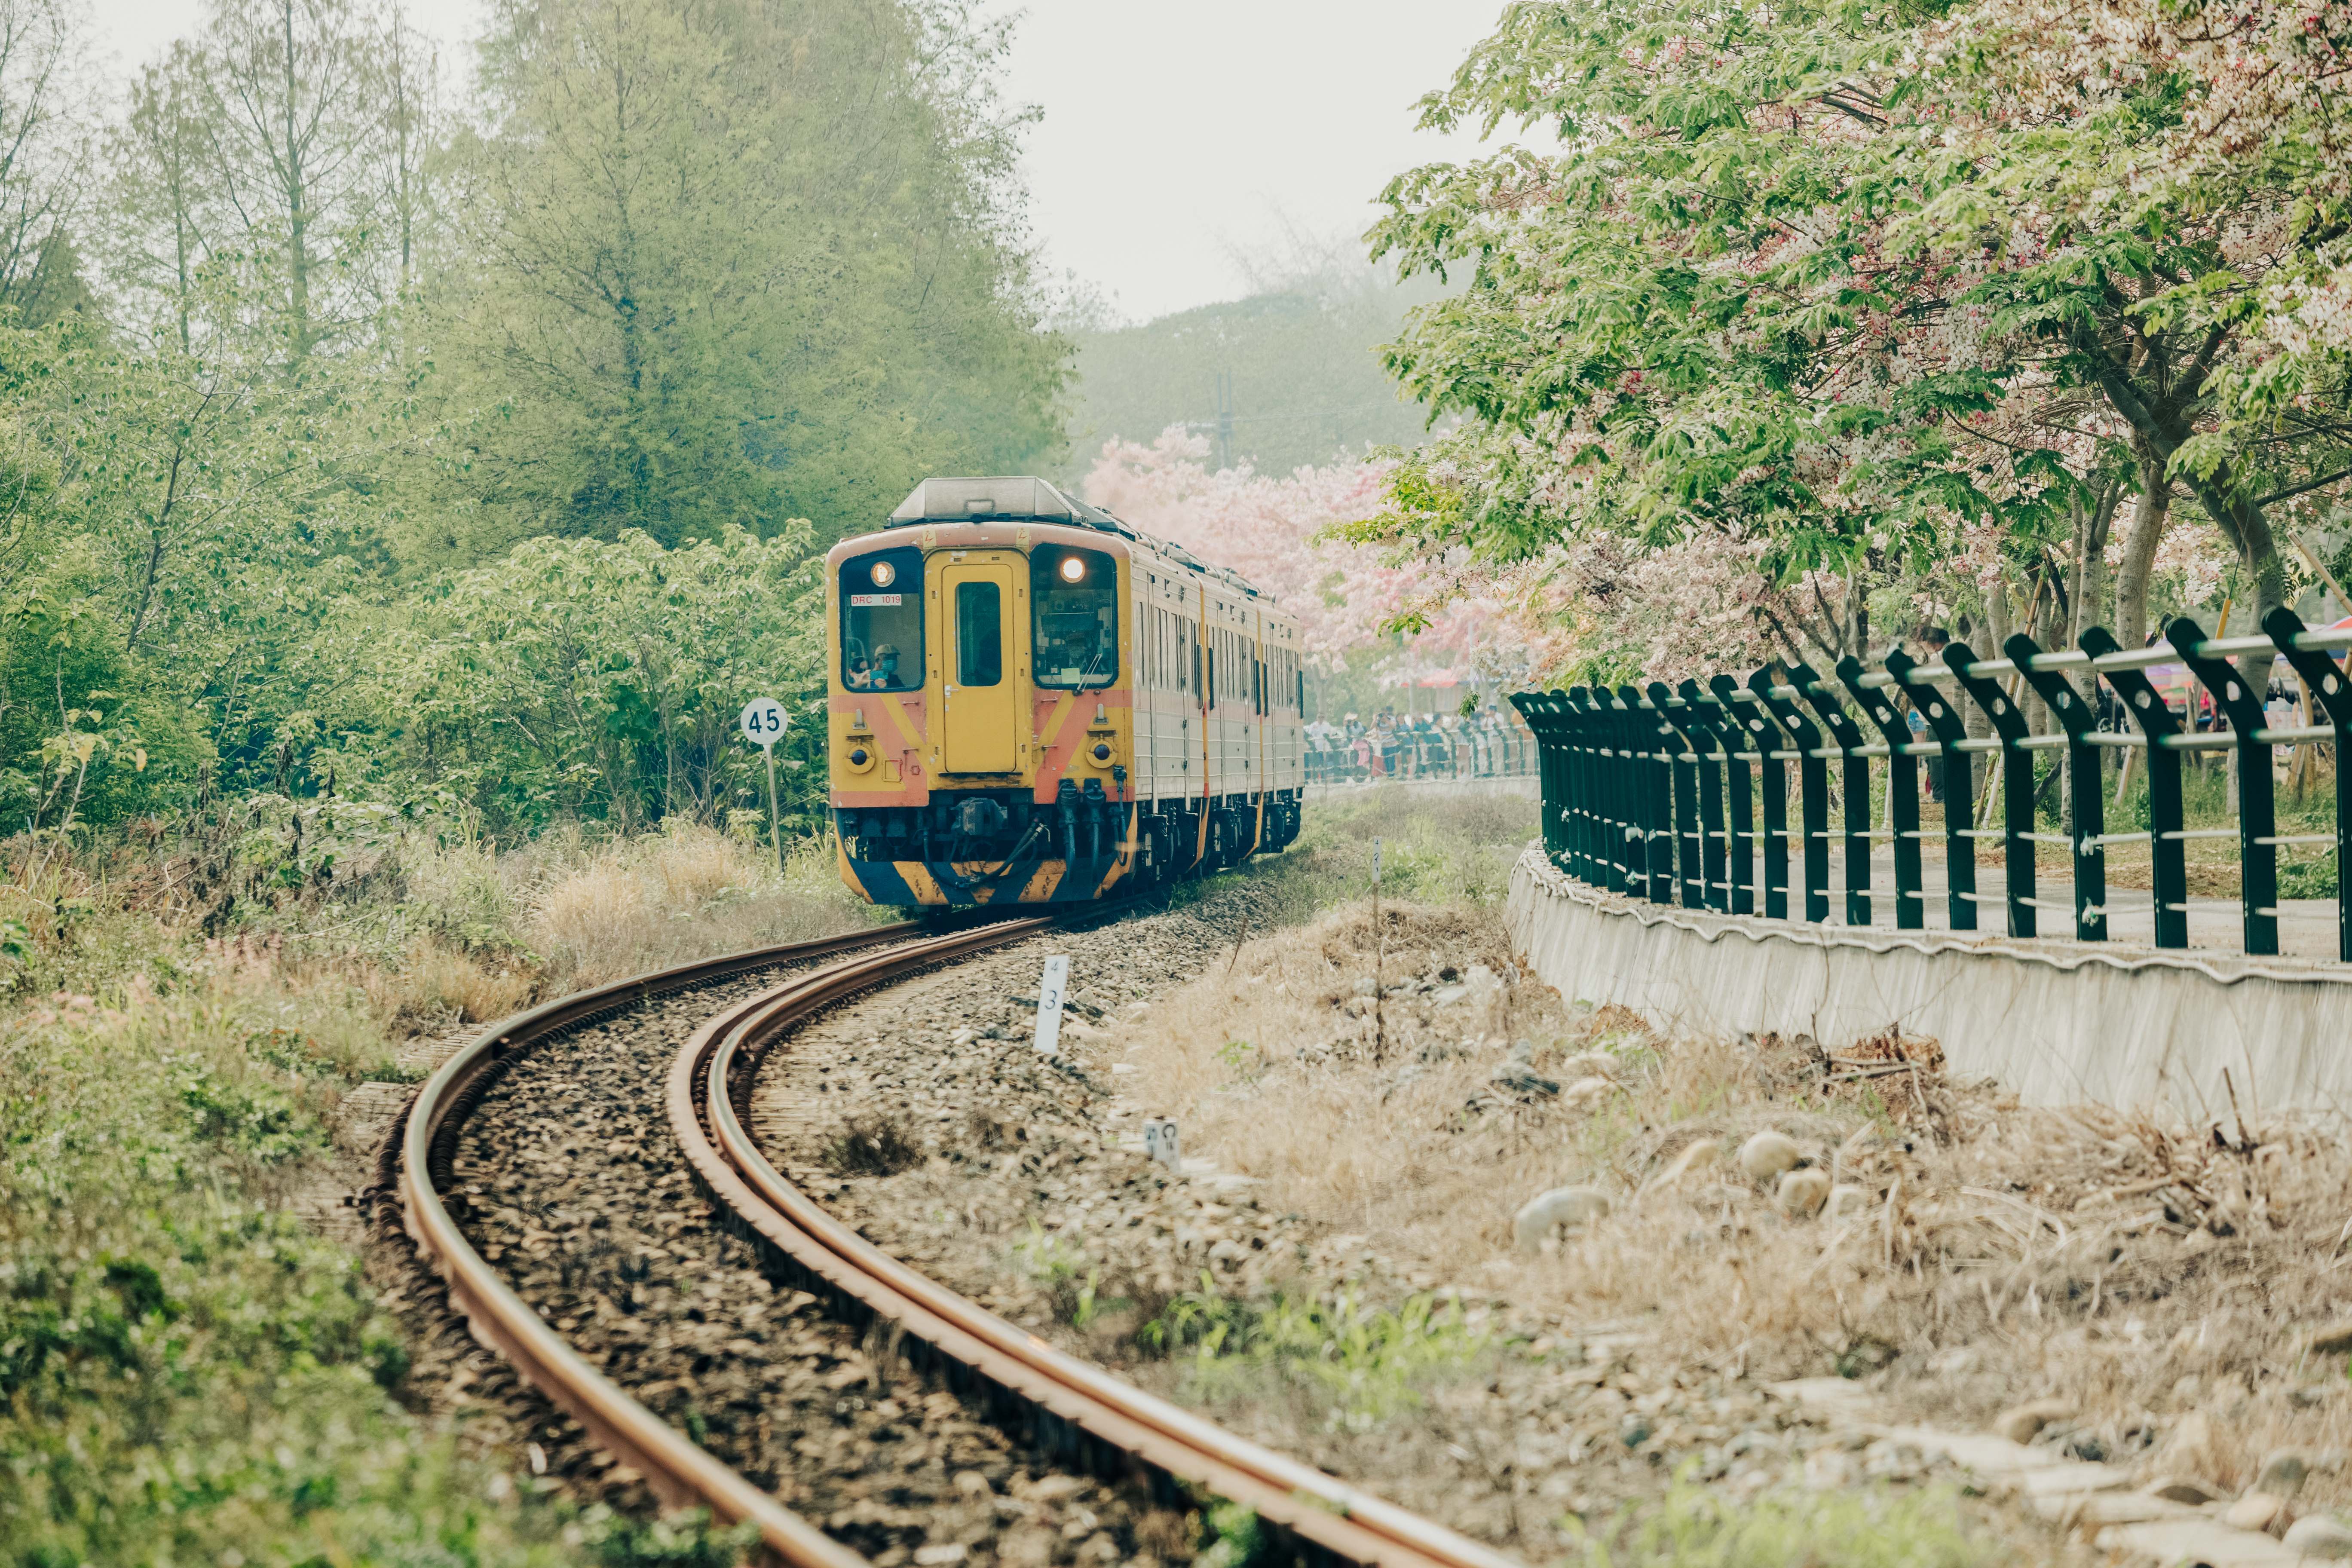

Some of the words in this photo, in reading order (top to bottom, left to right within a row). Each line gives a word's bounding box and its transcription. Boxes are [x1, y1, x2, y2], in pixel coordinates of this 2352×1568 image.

[749, 708, 780, 733] 45
[1050, 961, 1058, 972] 4
[1044, 990, 1057, 1010] 3
